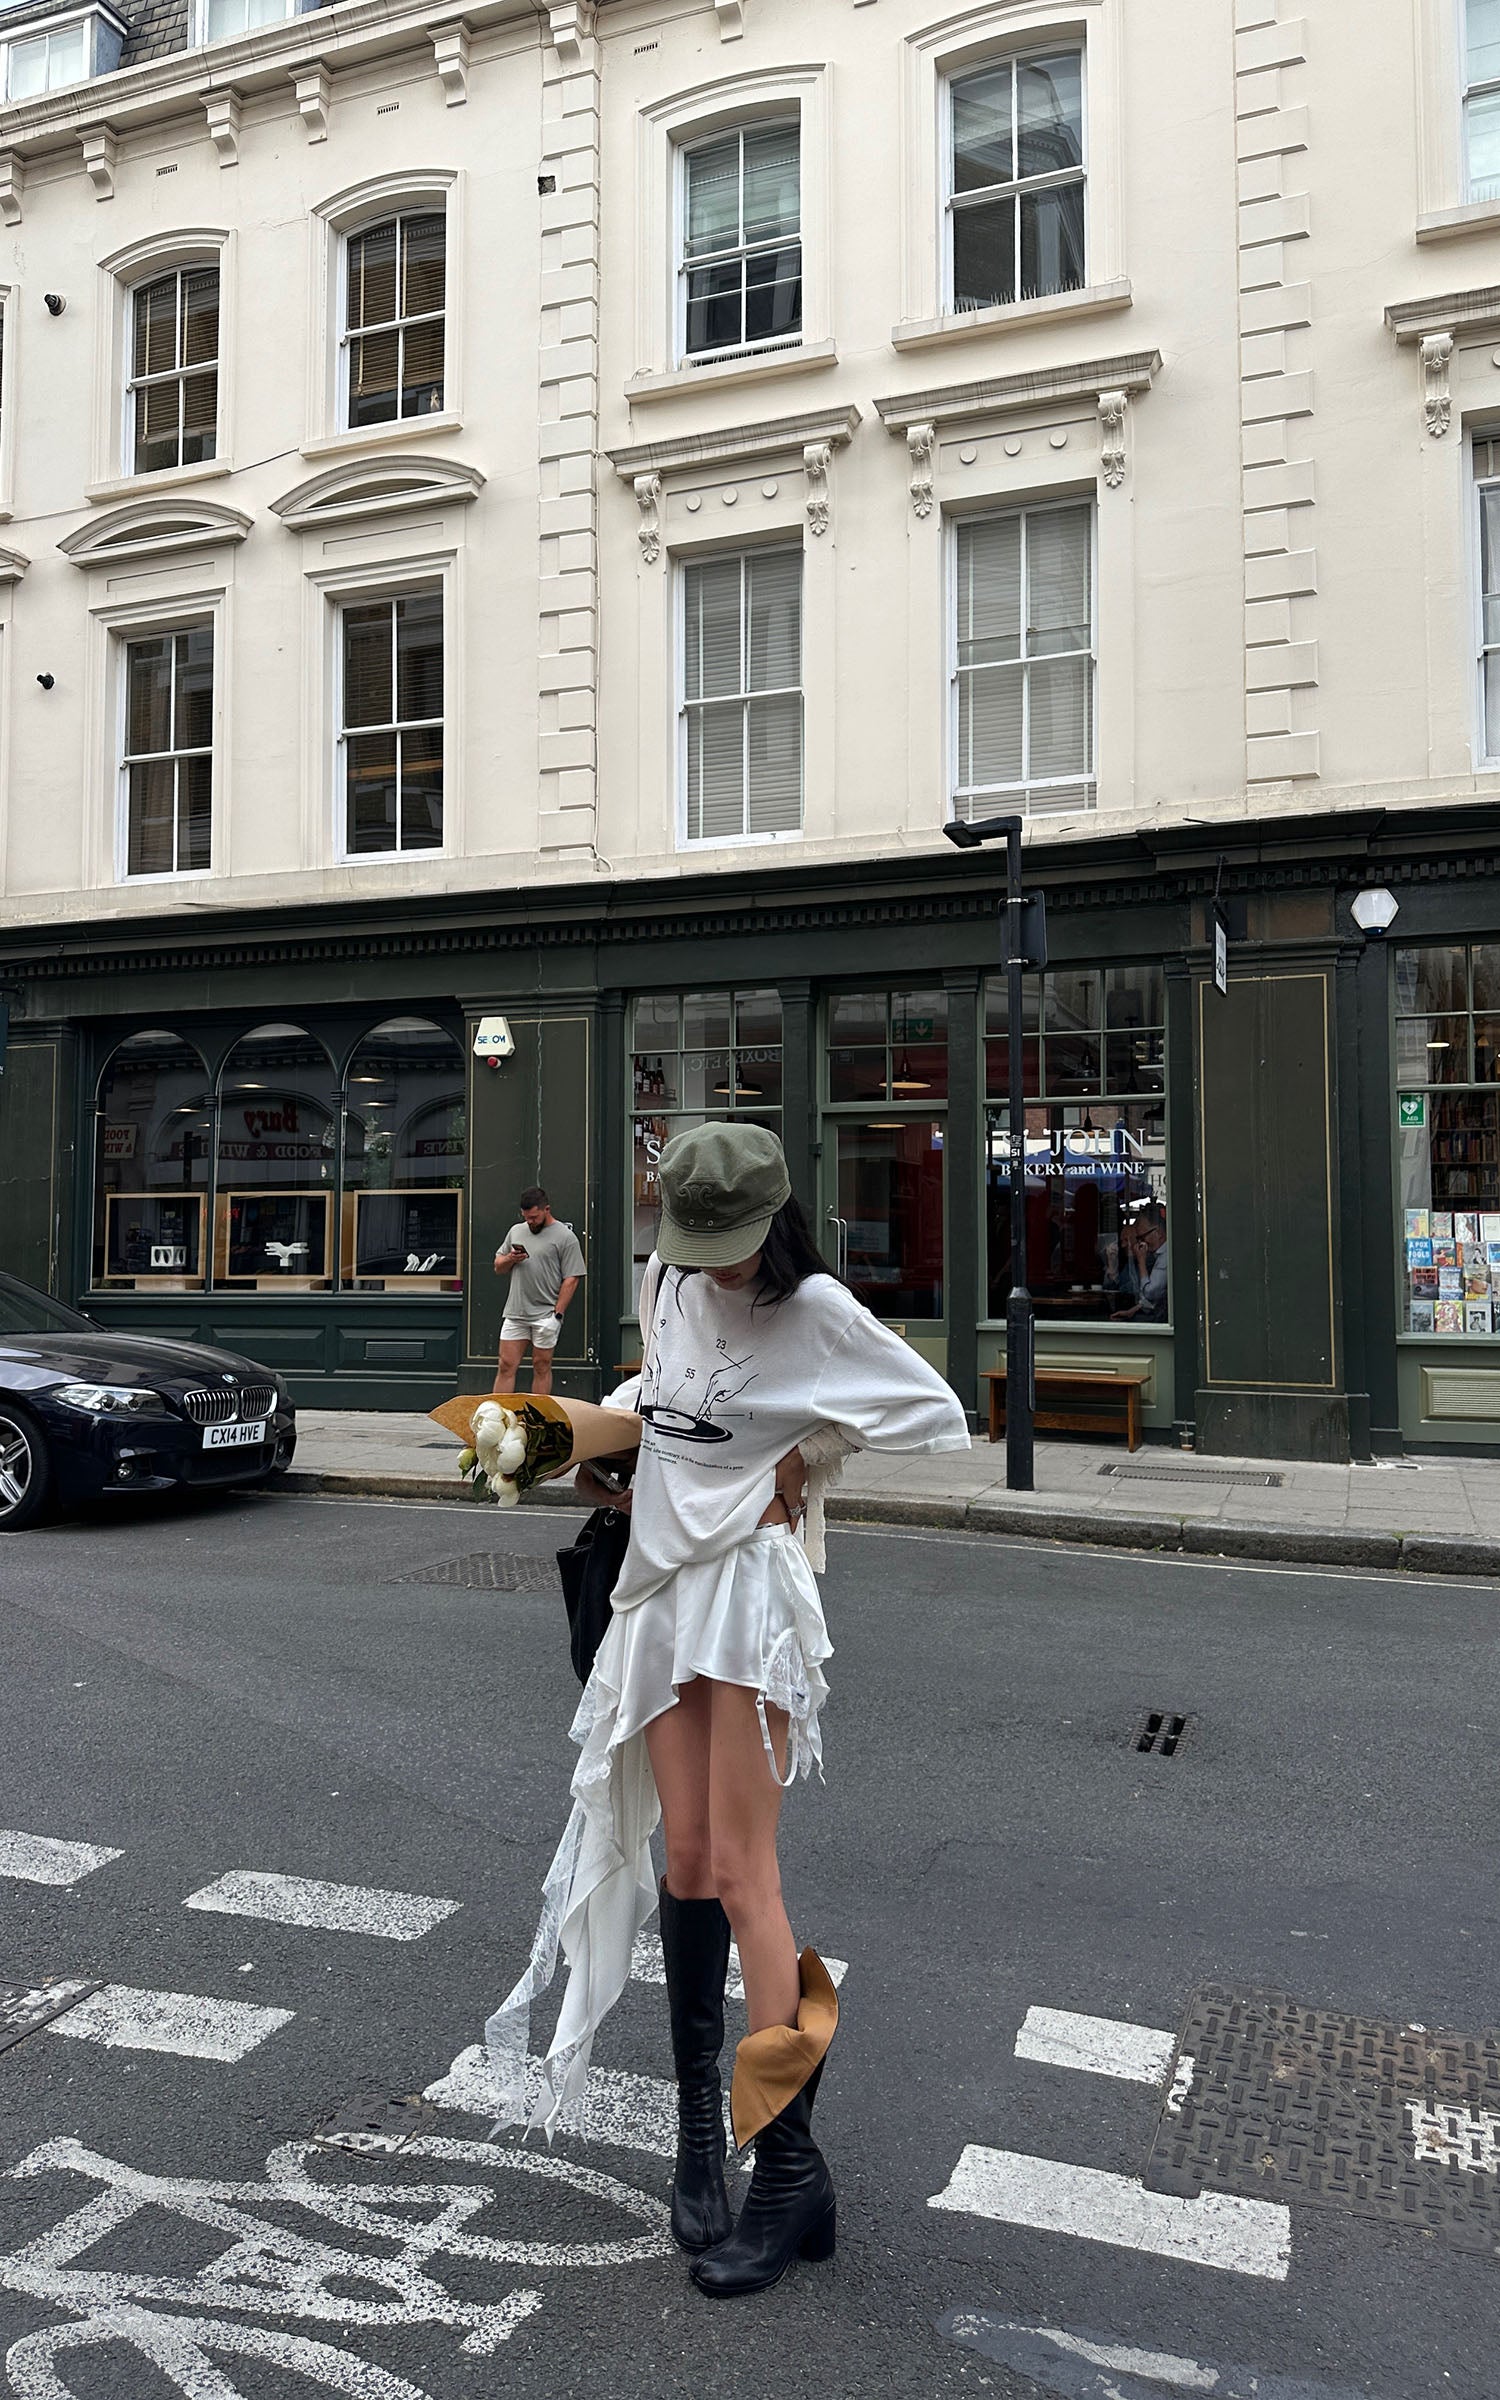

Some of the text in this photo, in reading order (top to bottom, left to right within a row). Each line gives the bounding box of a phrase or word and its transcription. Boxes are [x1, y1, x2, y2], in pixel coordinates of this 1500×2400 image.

[1050, 1128, 1146, 1157] JOHN
[1001, 1162, 1067, 1176] BKERY
[1070, 1162, 1096, 1175] and
[1101, 1161, 1145, 1175] WINE
[715, 1338, 727, 1350] 23
[684, 1367, 697, 1380] 55
[748, 1411, 754, 1420] 1
[211, 1427, 238, 1445] CX14
